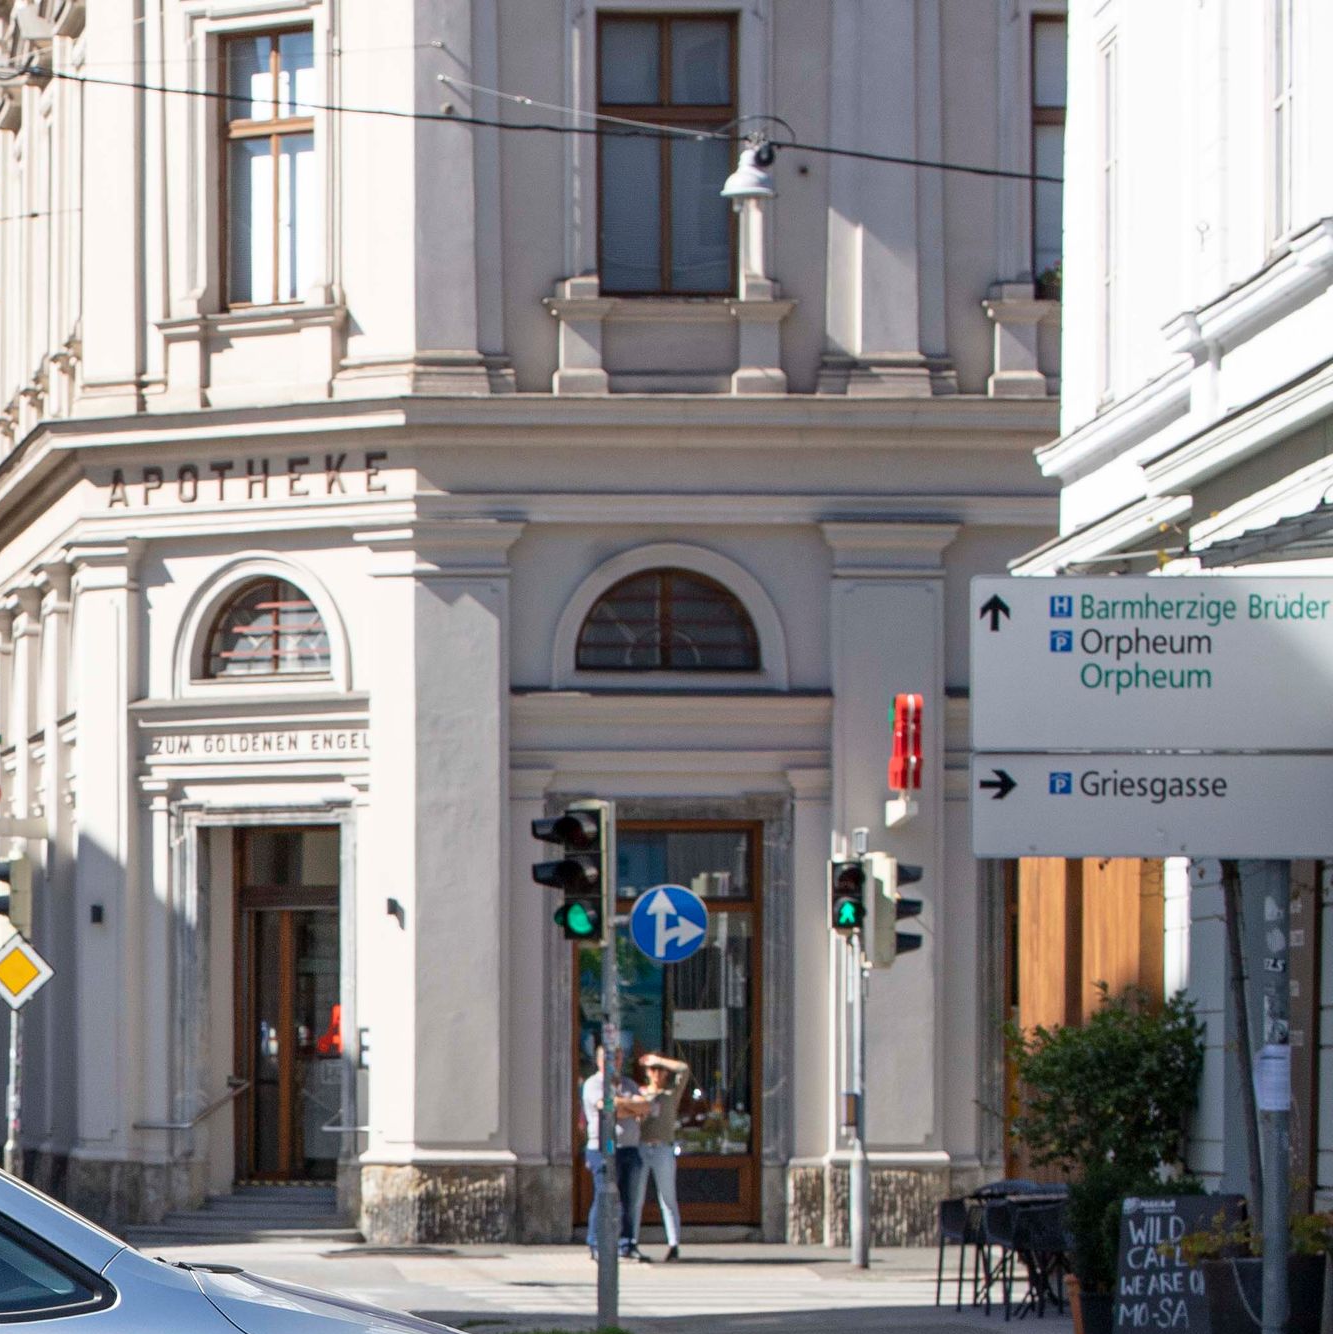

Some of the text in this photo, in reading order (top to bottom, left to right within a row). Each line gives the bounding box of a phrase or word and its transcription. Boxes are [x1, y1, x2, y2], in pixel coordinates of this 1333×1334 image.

[108, 450, 388, 508] APOTHEKE
[1080, 593, 1237, 626] Barmherzige
[1247, 593, 1330, 620] Brüder
[1080, 628, 1212, 660] Orpheum
[1080, 662, 1212, 695] Orpheum
[152, 731, 371, 755] ZUM GOLDENEN ENGEL
[1080, 769, 1228, 804] Griesgasse
[1128, 1215, 1186, 1245] WILD
[1120, 1274, 1146, 1296] WE
[1147, 1271, 1185, 1296] ARE
[1118, 1297, 1190, 1329] MO-SA
